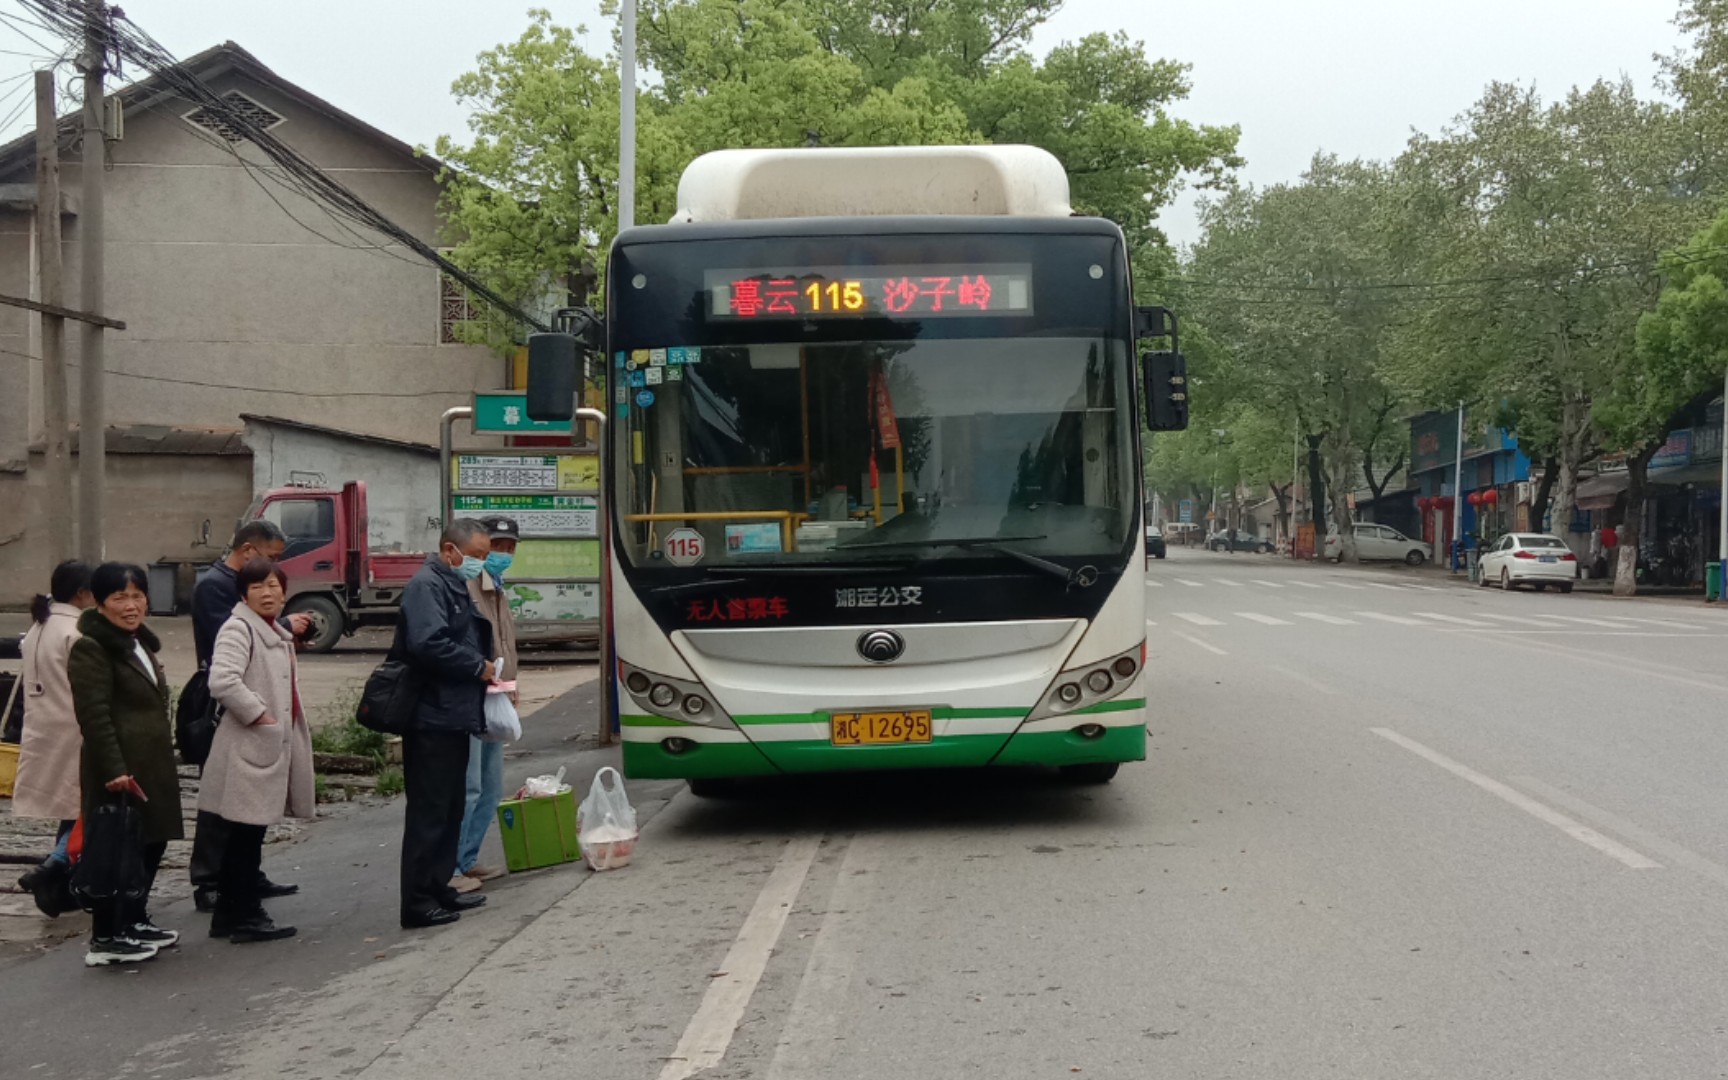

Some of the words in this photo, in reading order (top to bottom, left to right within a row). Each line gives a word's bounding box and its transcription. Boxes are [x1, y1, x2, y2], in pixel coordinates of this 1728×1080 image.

[729, 279, 799, 318] 暮云
[805, 281, 865, 311] 115
[882, 274, 993, 314] 沙子岭
[667, 538, 700, 557] 115
[686, 596, 790, 621] 无人售票车
[835, 585, 923, 608] 湘运公交
